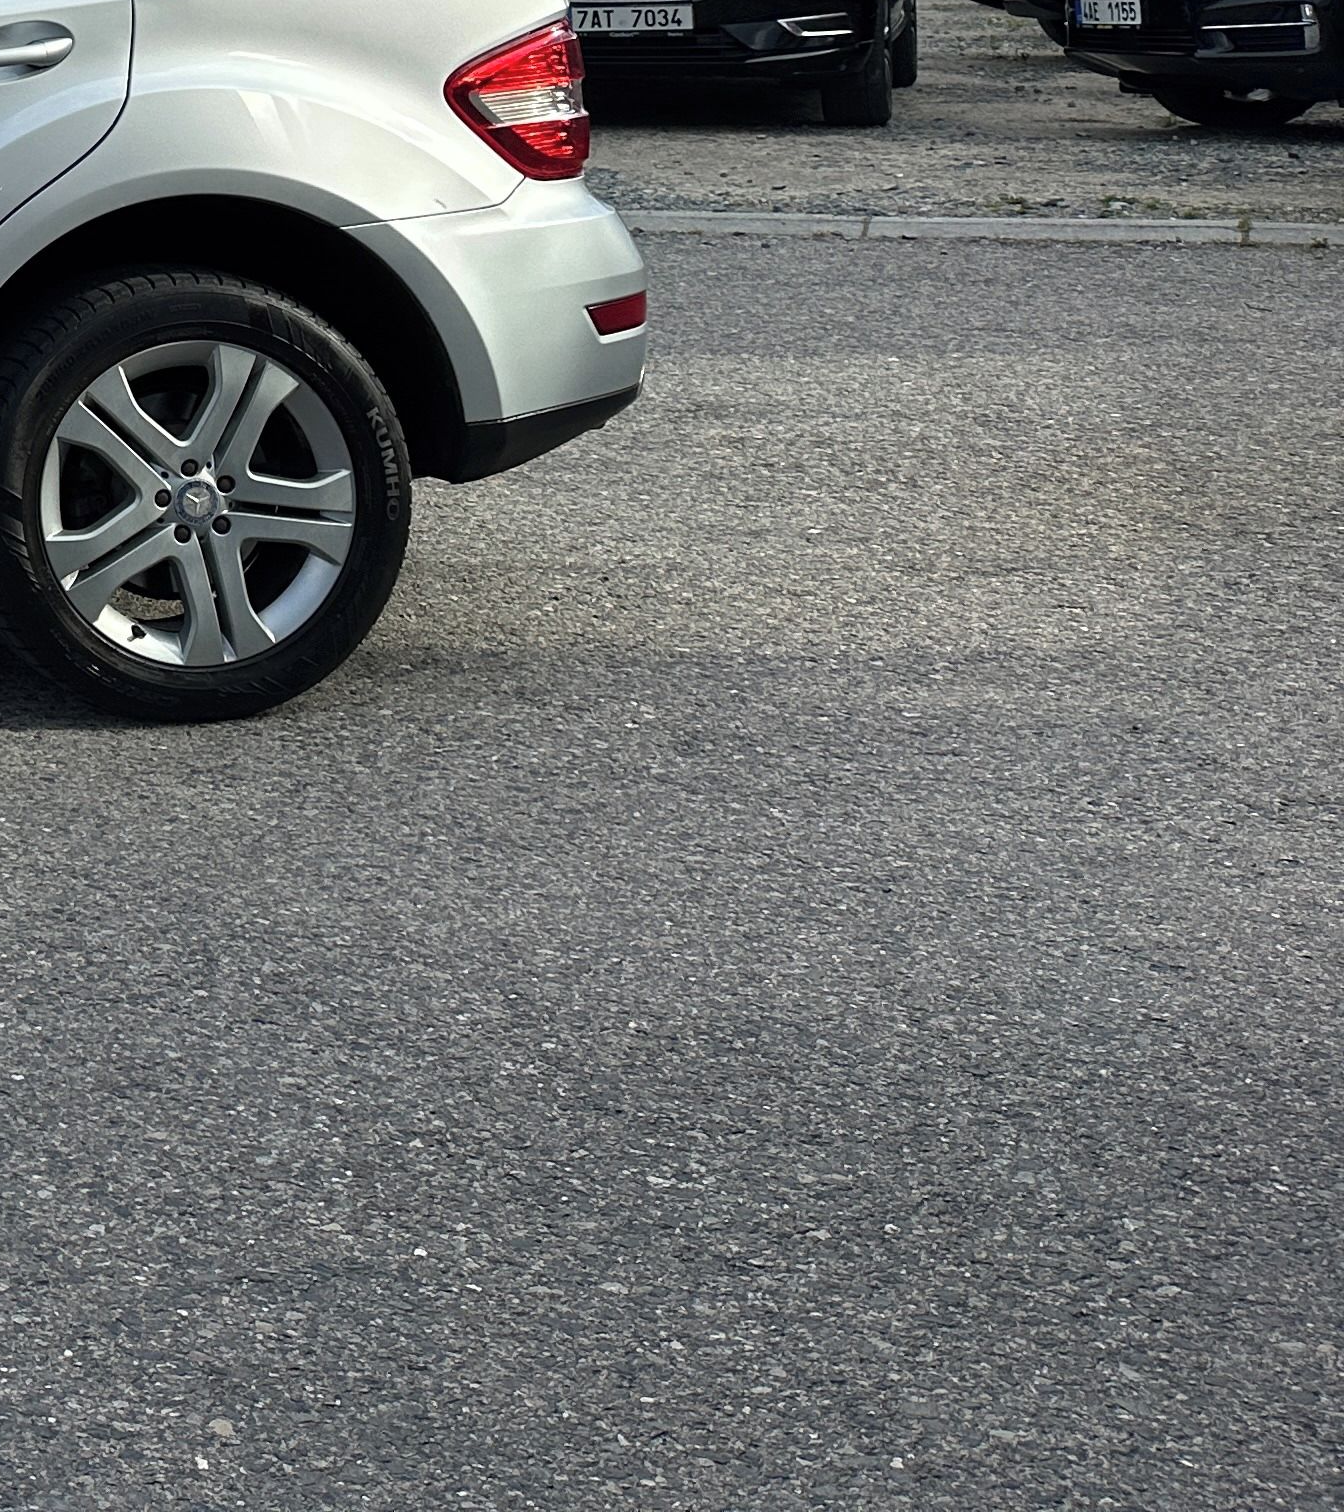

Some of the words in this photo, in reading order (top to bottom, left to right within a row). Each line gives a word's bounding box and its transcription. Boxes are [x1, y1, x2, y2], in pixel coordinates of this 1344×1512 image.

[577, 10, 615, 29] 7AT
[631, 9, 683, 28] 7034
[1083, 1, 1100, 22] 4AE
[1107, 1, 1137, 22] 1155
[366, 406, 401, 521] KUMHO
